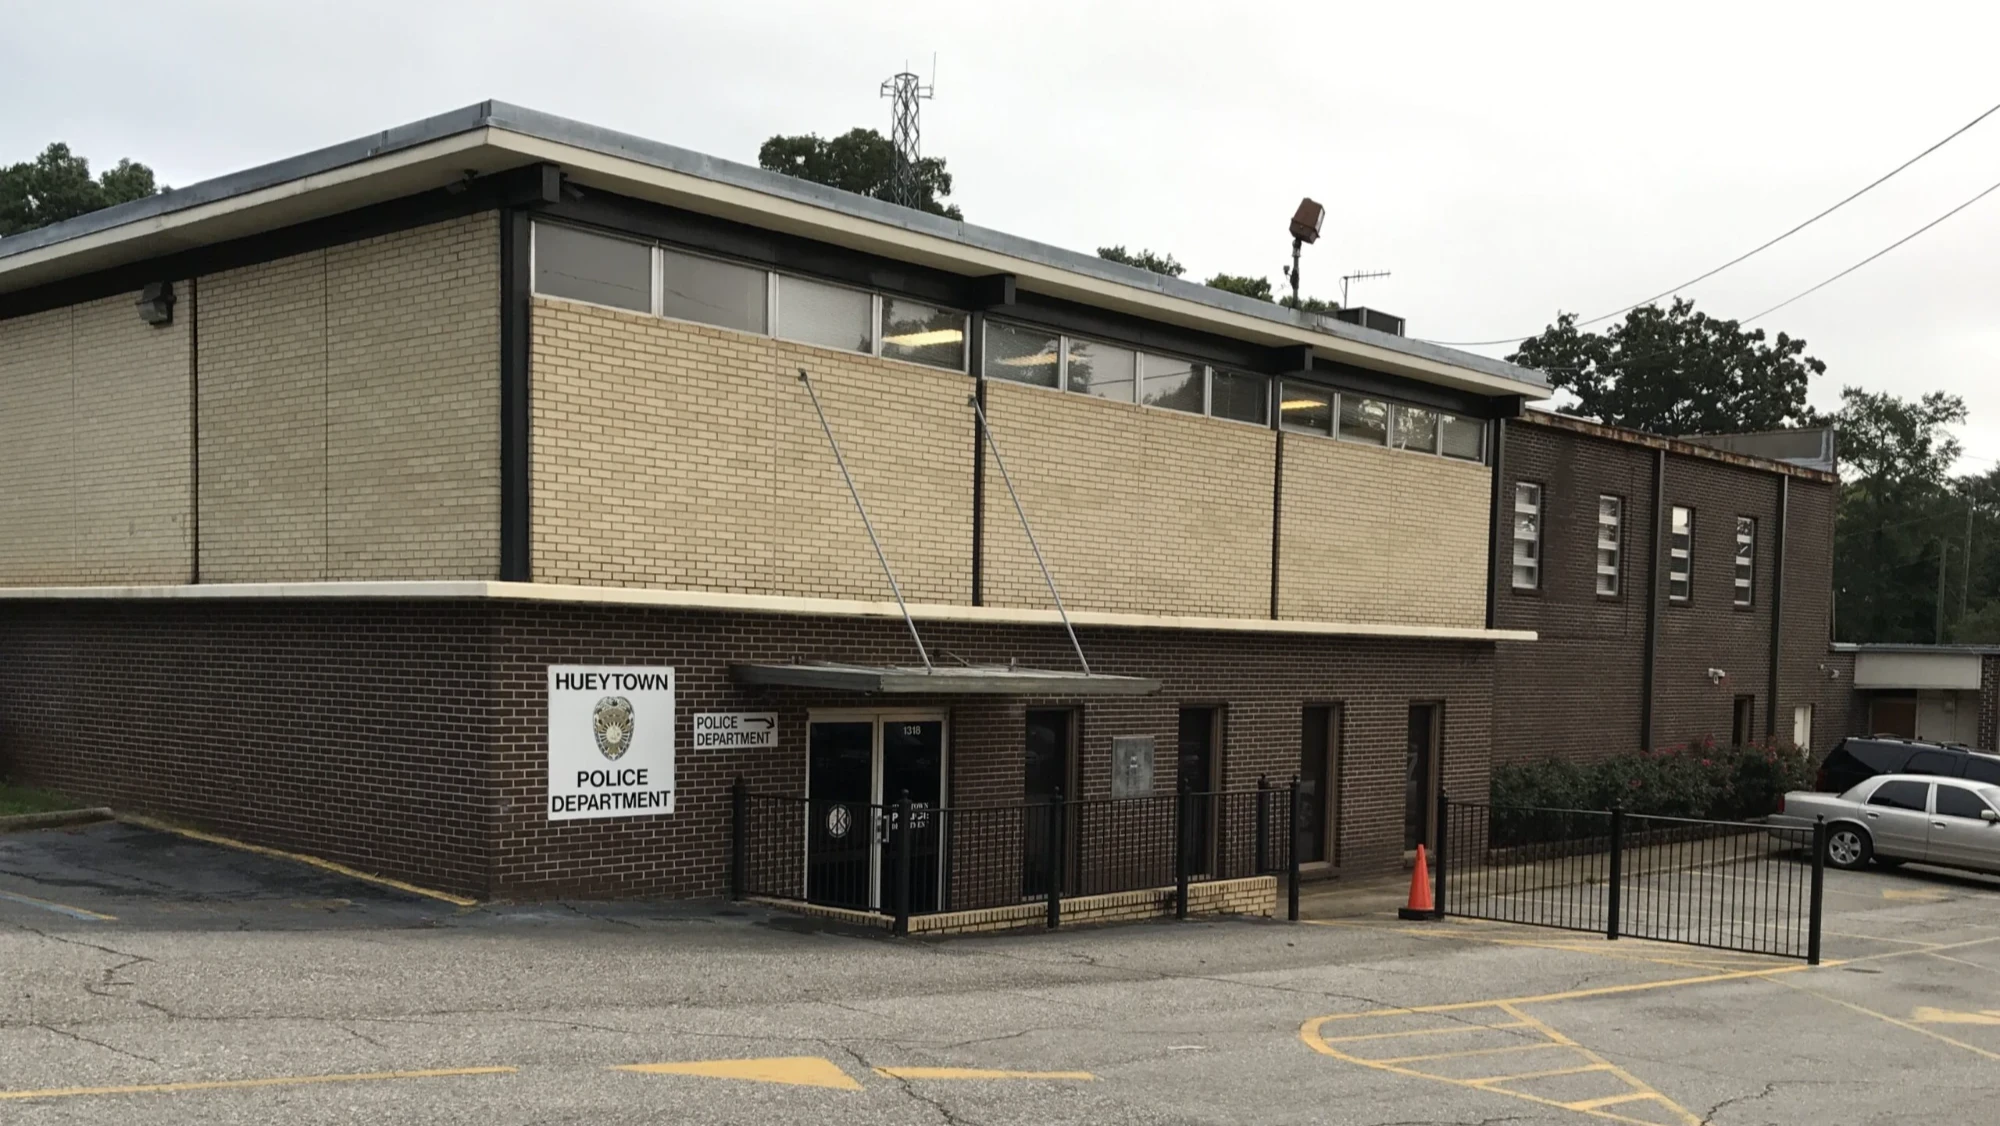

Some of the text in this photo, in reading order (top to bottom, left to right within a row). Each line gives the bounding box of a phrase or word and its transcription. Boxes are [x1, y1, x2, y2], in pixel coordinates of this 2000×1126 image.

[555, 672, 669, 691] HUEYTOWN
[696, 715, 739, 730] POLICE
[903, 725, 921, 736] 1318
[696, 731, 772, 747] DEPARTMENT
[577, 768, 649, 788] POLICE
[551, 790, 671, 814] DEPARTMENT
